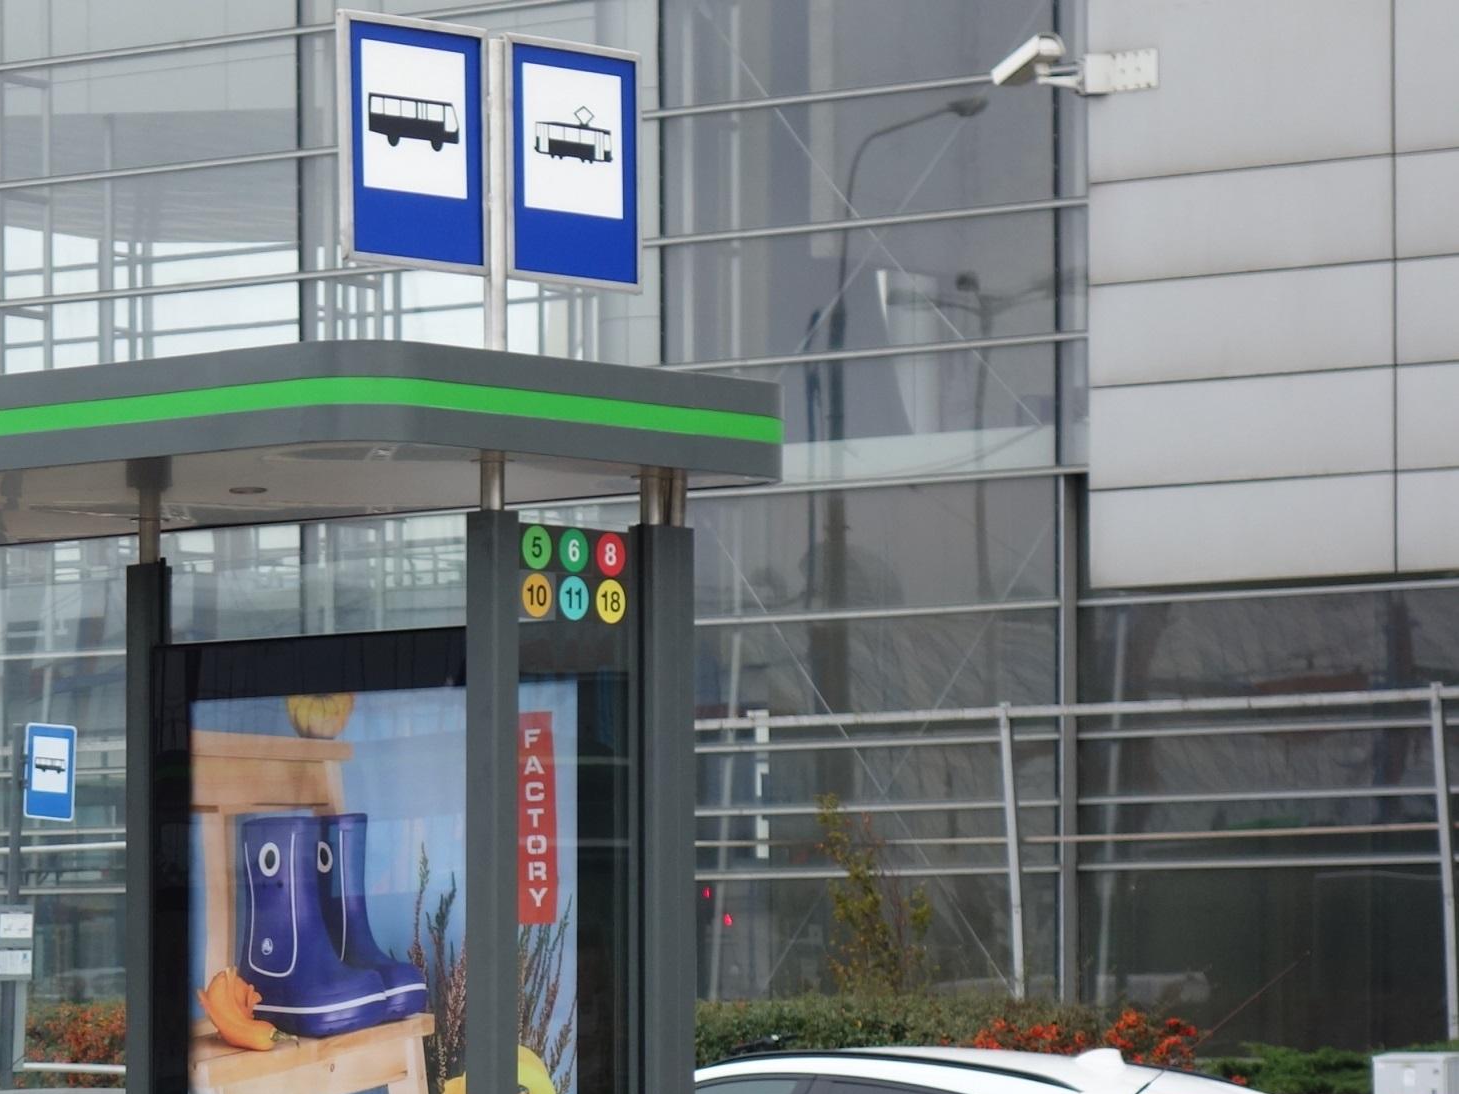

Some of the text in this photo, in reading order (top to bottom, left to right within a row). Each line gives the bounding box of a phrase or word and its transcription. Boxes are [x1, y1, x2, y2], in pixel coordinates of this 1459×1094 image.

[532, 536, 617, 566] 5 6 8
[527, 584, 621, 612] 10 11 18
[524, 728, 548, 908] FACTORY
